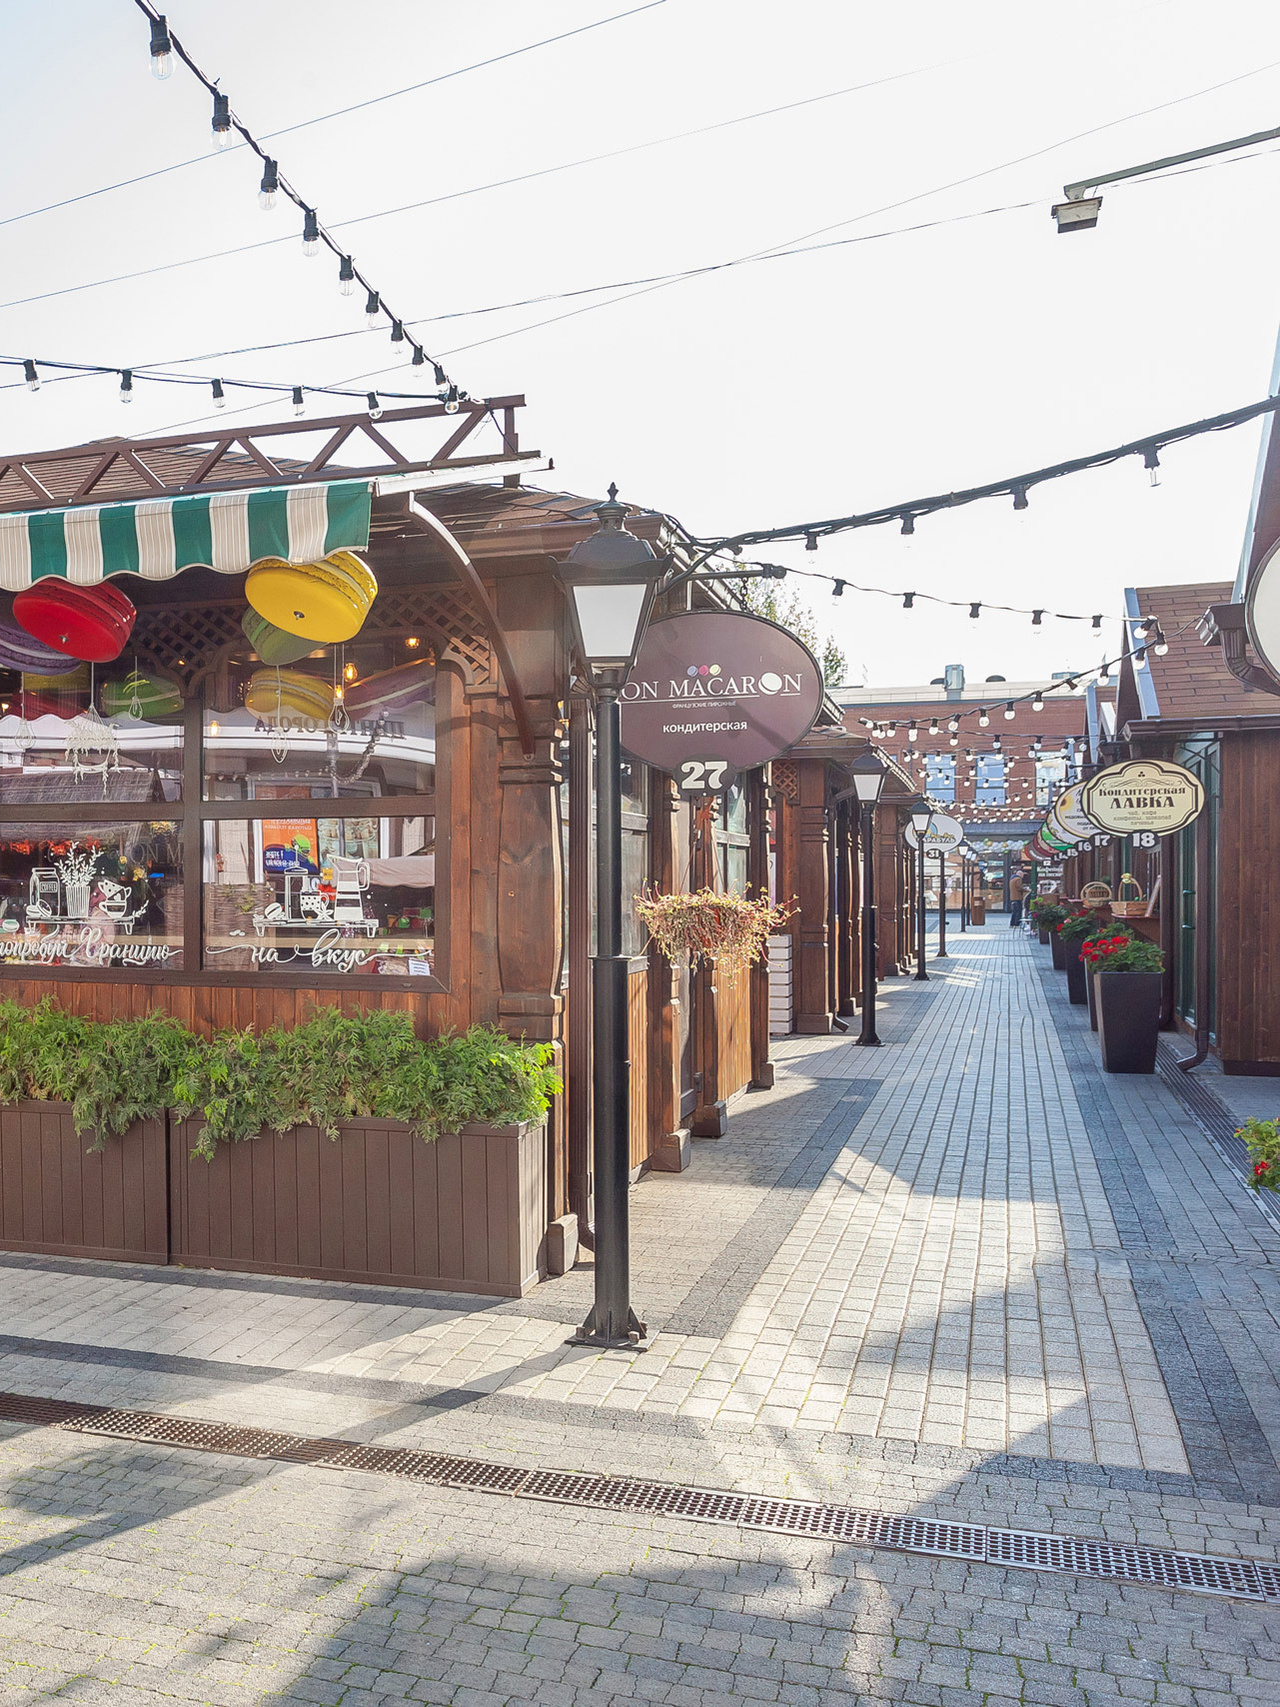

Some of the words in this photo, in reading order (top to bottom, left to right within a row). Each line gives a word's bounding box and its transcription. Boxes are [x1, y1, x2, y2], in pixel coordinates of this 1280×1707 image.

[619, 681, 660, 701] ON
[669, 672, 803, 699] MACARON
[663, 720, 748, 735] кондитерская
[680, 760, 728, 791] 27
[1099, 787, 1186, 797] Кондитерская
[1110, 796, 1175, 809] ЛАВКА
[1094, 834, 1111, 847] 17
[1132, 831, 1156, 848] 18
[1066, 848, 1079, 857] 15
[1078, 841, 1092, 852] 16
[928, 850, 939, 858] 31
[70, 927, 176, 966] Францию
